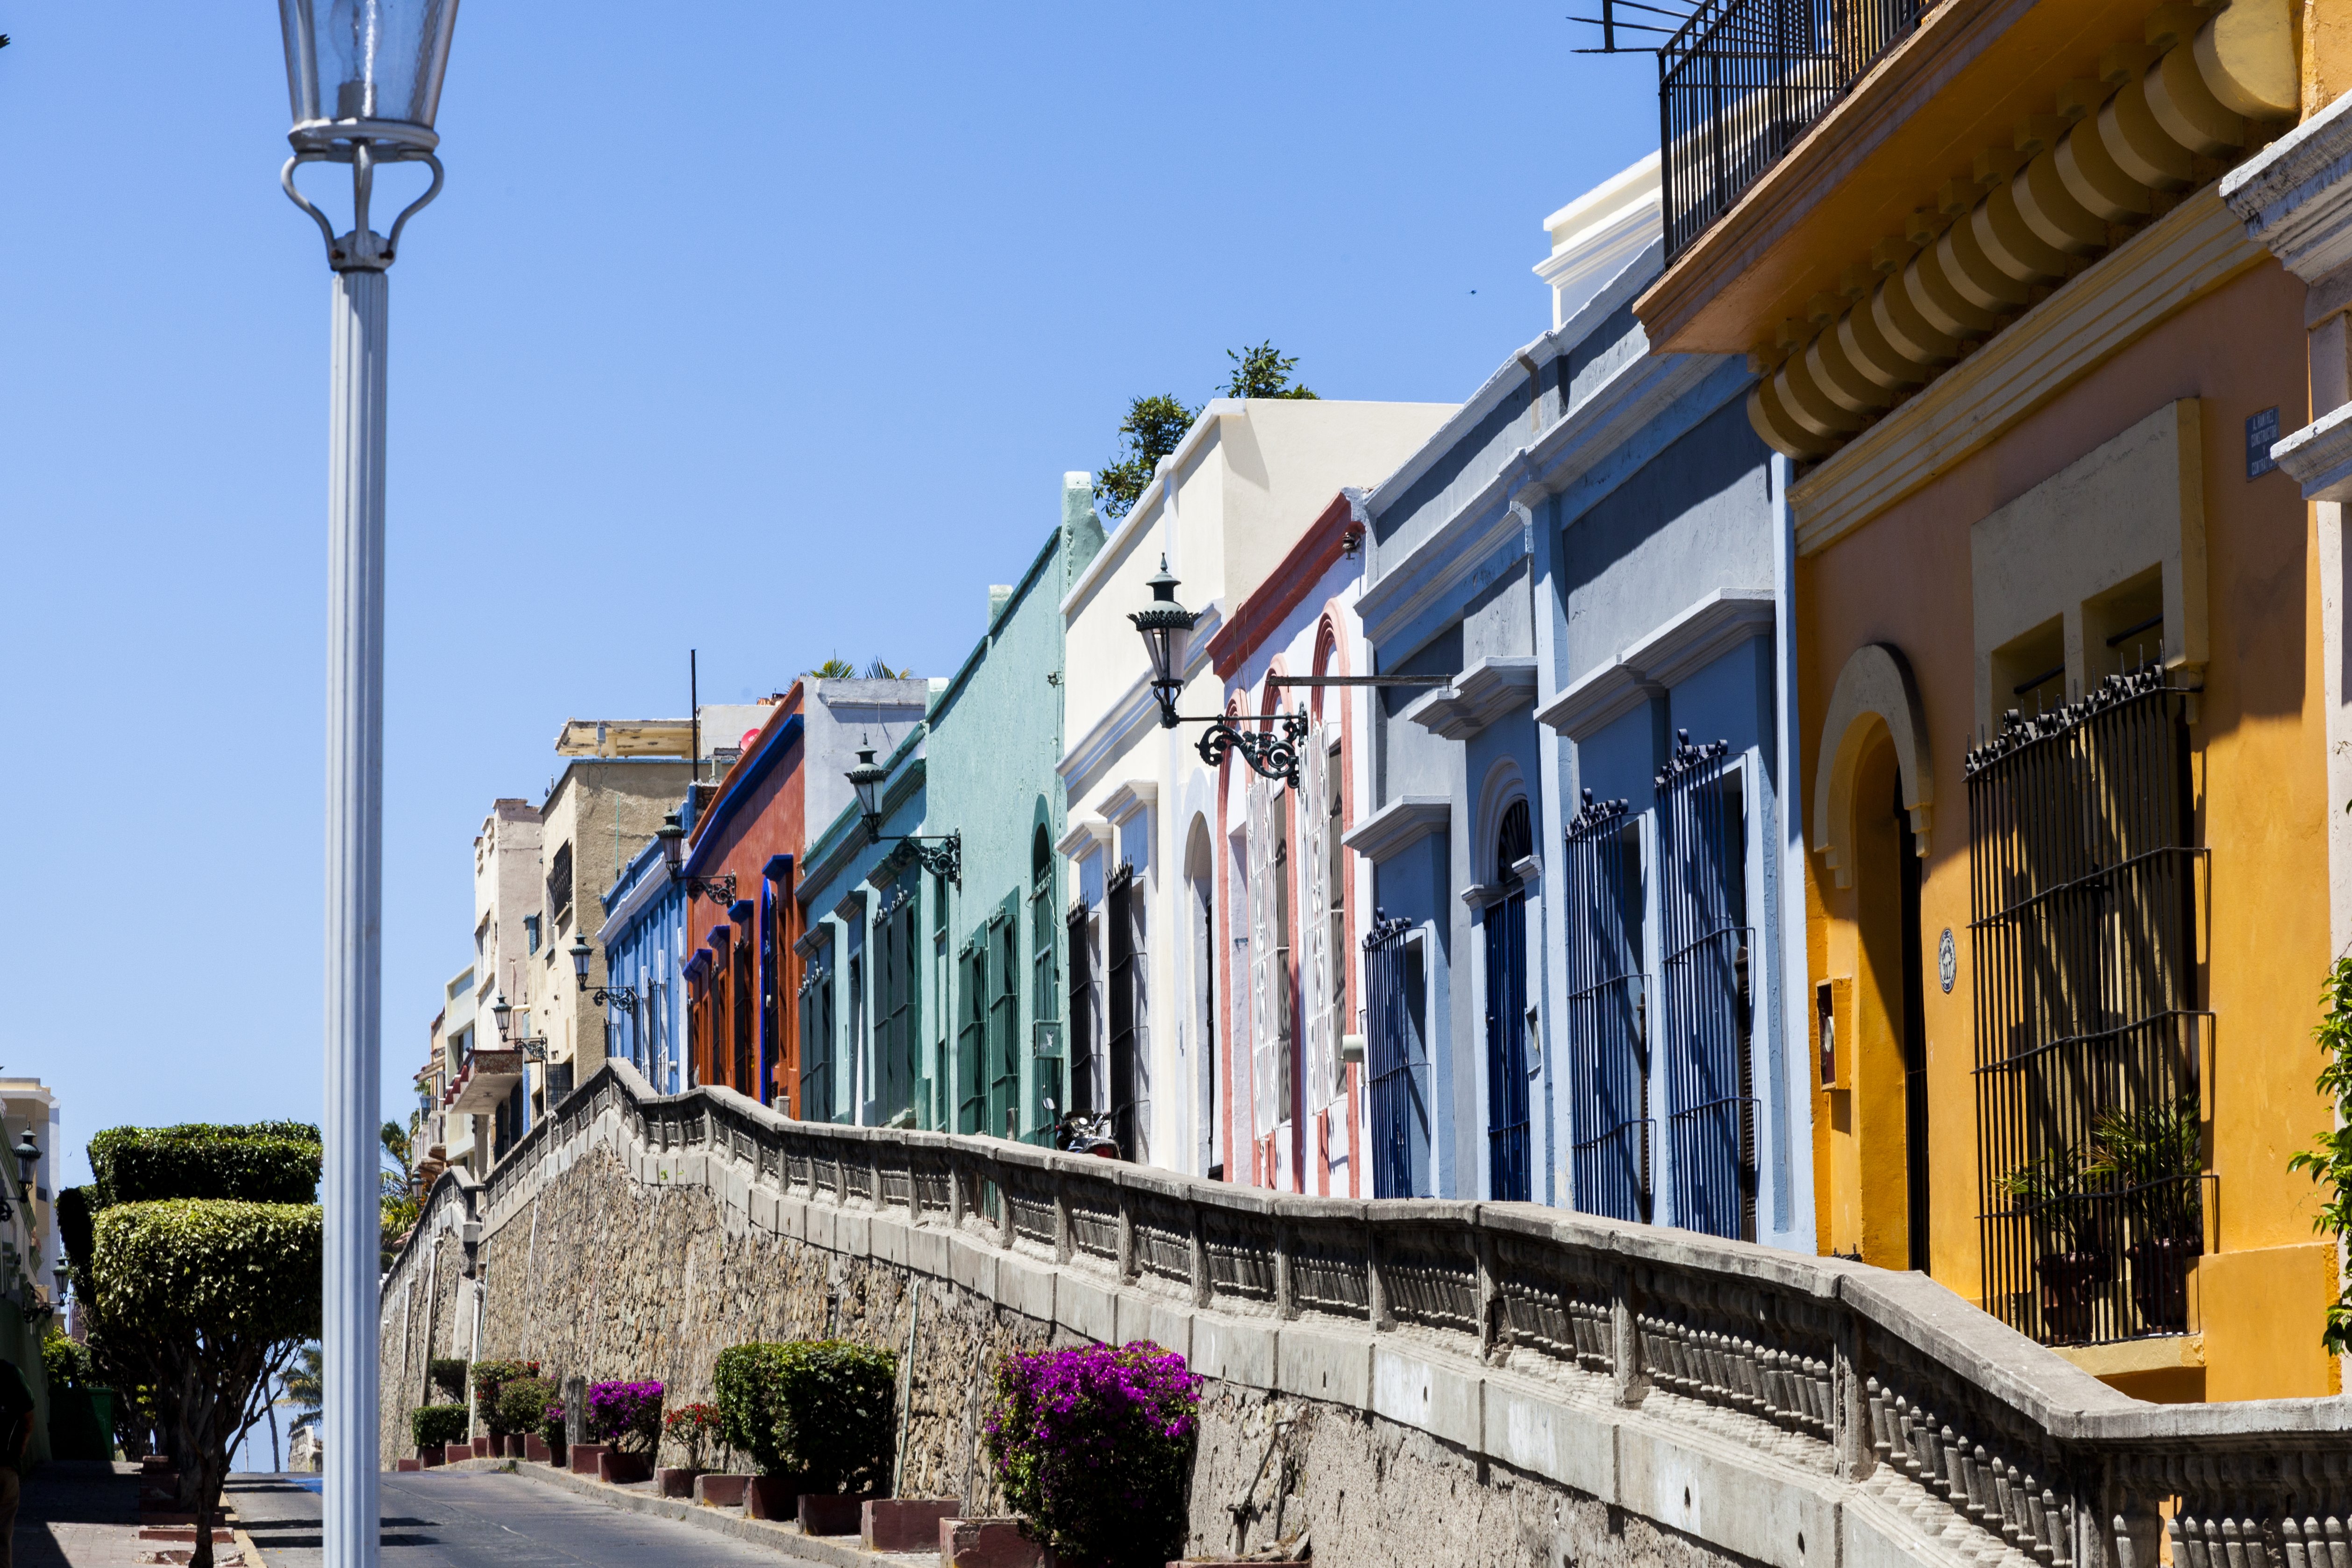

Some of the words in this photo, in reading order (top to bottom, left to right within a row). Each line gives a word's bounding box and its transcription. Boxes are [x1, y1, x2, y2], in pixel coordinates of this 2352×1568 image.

[2258, 410, 2274, 429] RAMIREZ
[2251, 425, 2277, 447] CONSTRUCTOR
[2262, 444, 2266, 455] Y
